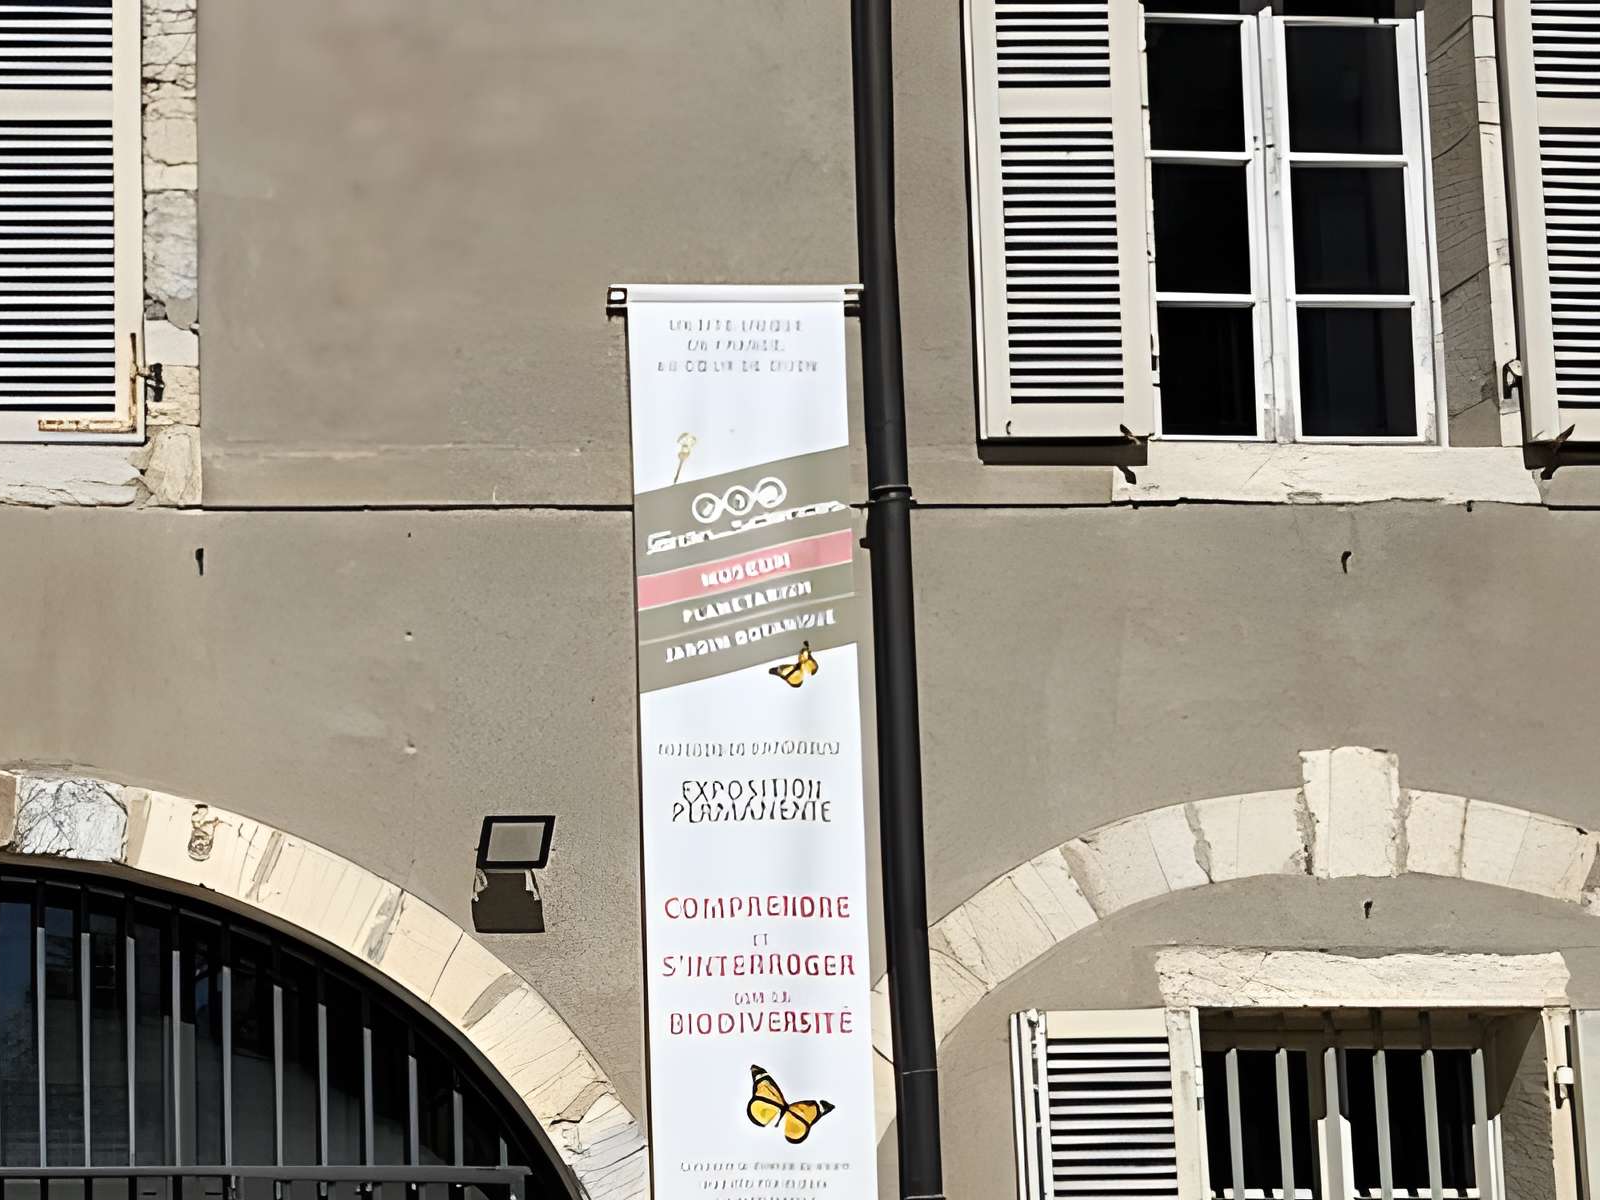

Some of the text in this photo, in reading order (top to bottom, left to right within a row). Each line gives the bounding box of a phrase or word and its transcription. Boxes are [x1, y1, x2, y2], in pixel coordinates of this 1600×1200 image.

[681, 778, 822, 804] EXPOSITION
[663, 894, 852, 920] COMPRENDRE
[661, 953, 856, 978] S'INTERROGER
[669, 1005, 854, 1036] BIODIVERSITÉ
